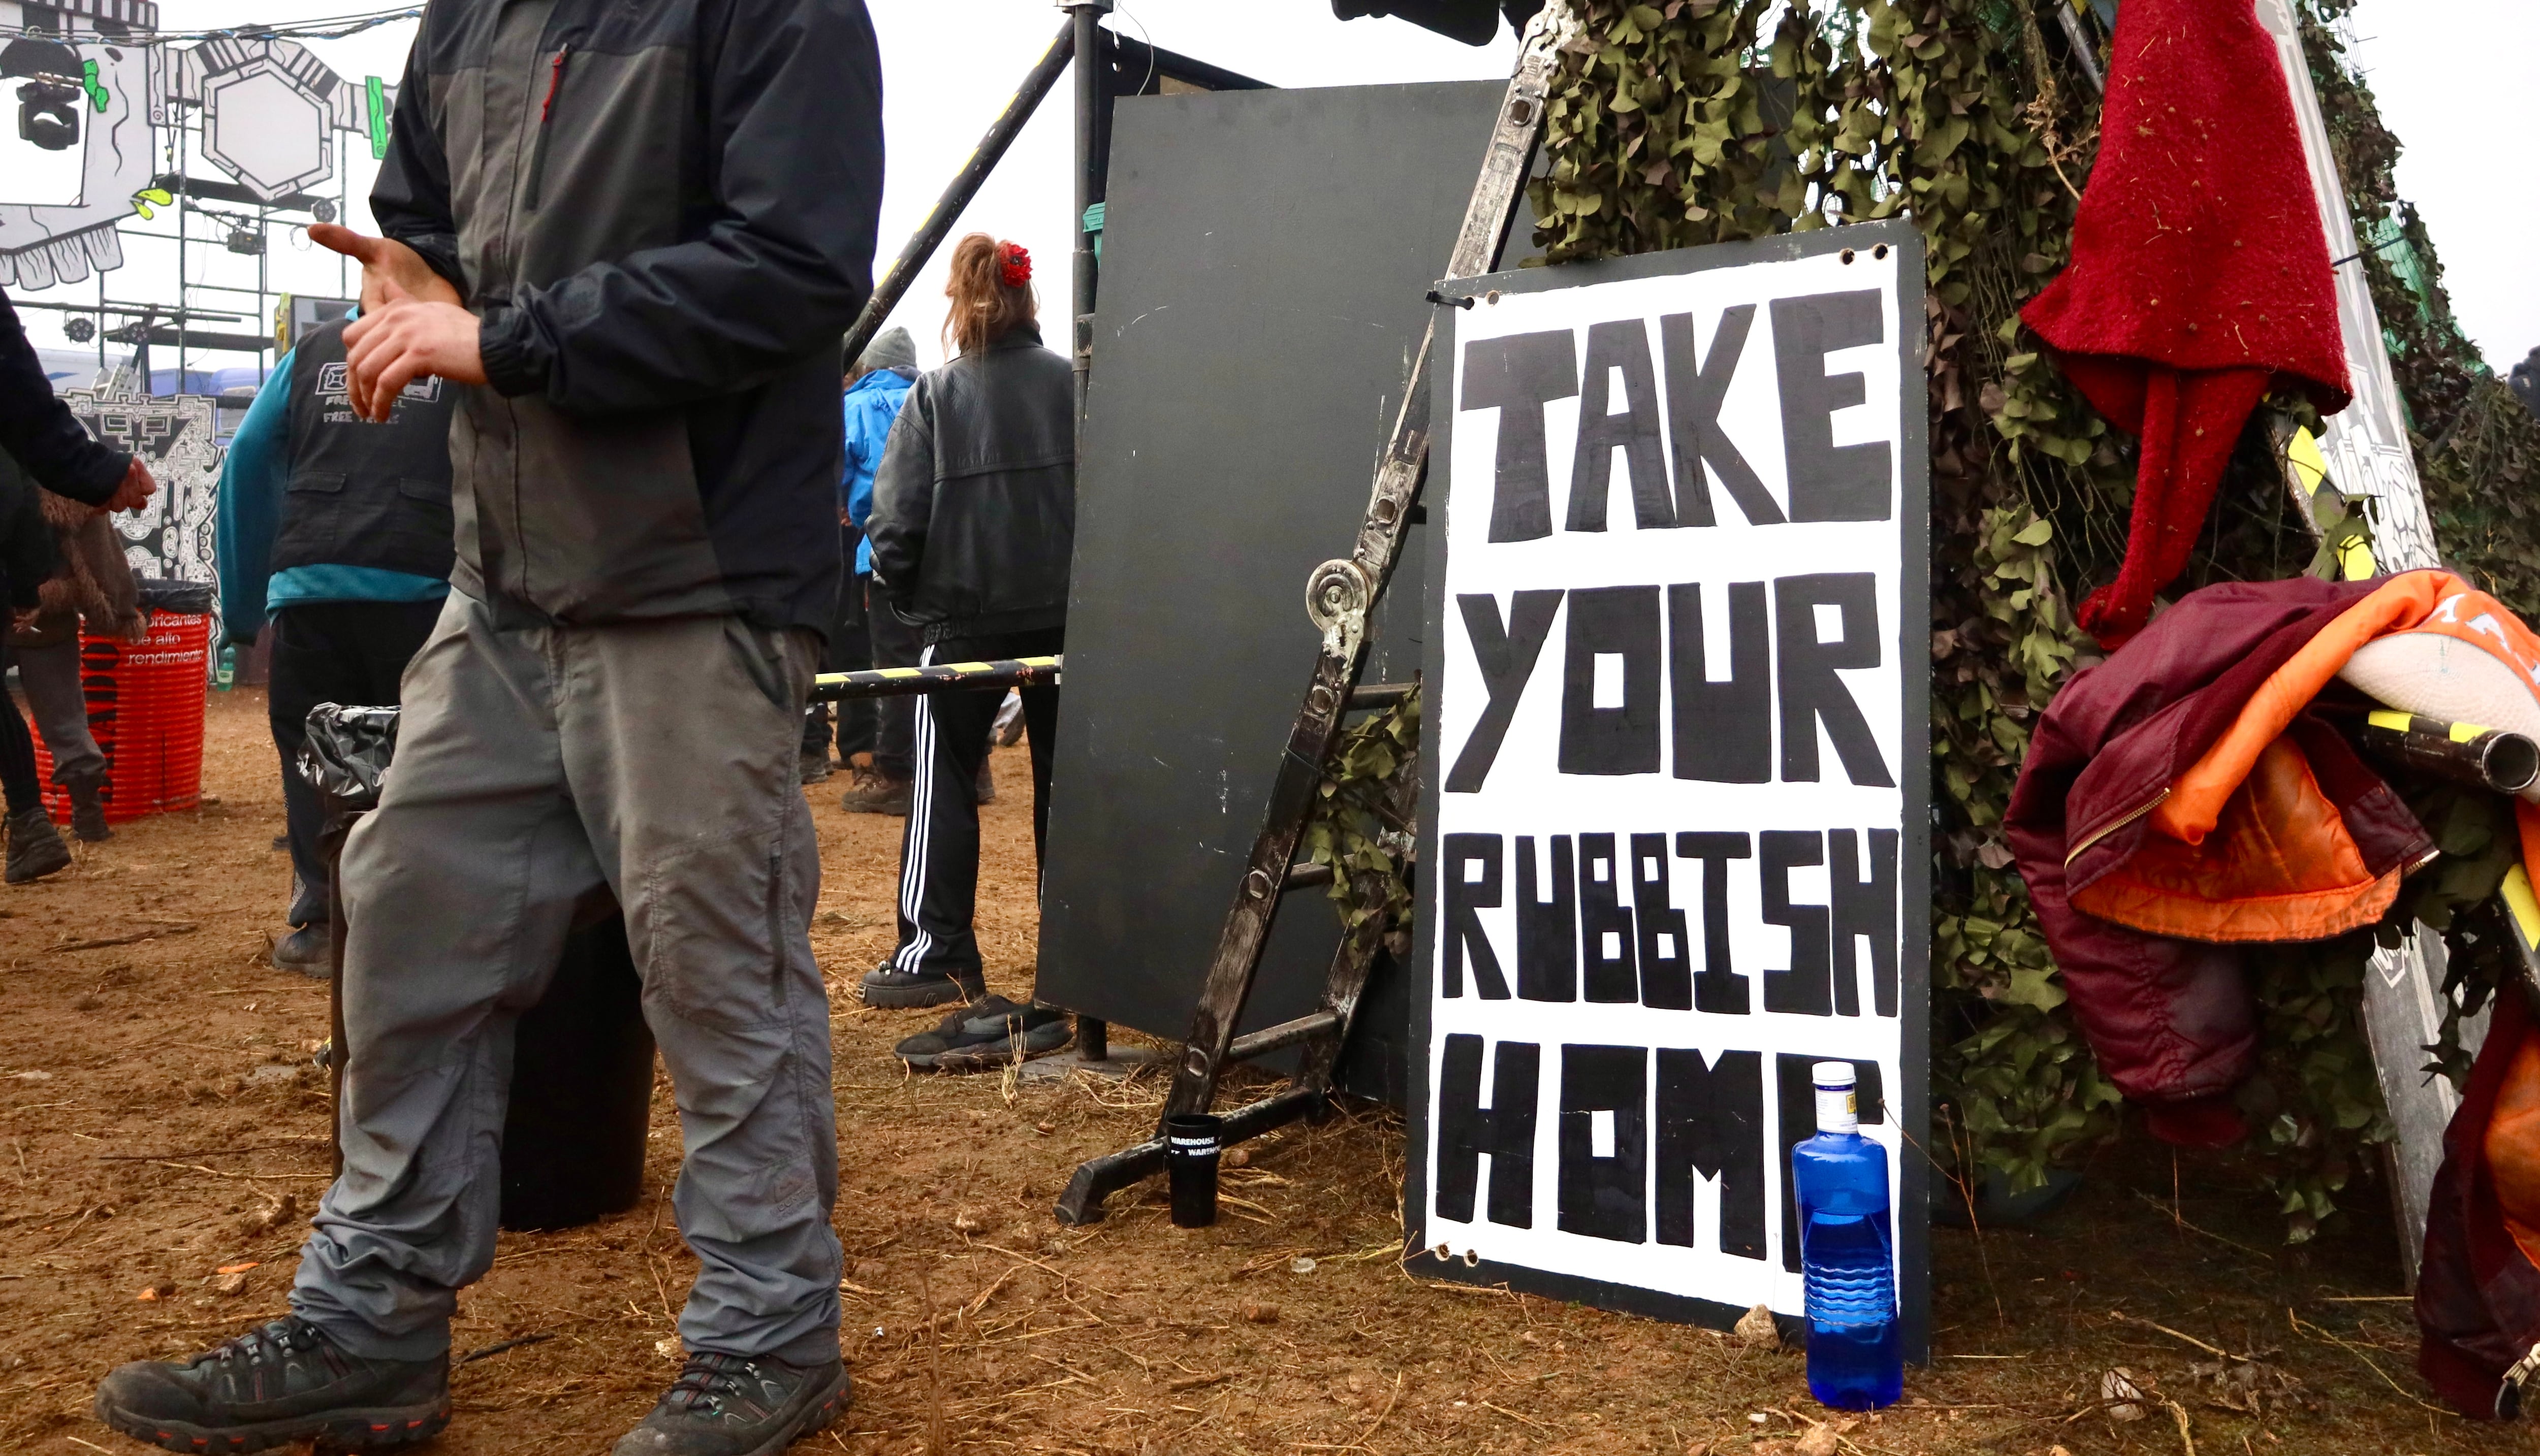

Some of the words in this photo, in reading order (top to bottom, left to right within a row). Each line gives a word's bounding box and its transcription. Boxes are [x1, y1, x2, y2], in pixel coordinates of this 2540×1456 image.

[325, 395, 351, 406] FRE
[323, 411, 353, 423] FREE
[1460, 287, 1892, 543] TAKE
[129, 649, 204, 664] rendimiento
[1444, 572, 1896, 793] YOUR
[1443, 828, 1899, 1017] RUBBISH
[1170, 1136, 1215, 1145] WAREHOUSE
